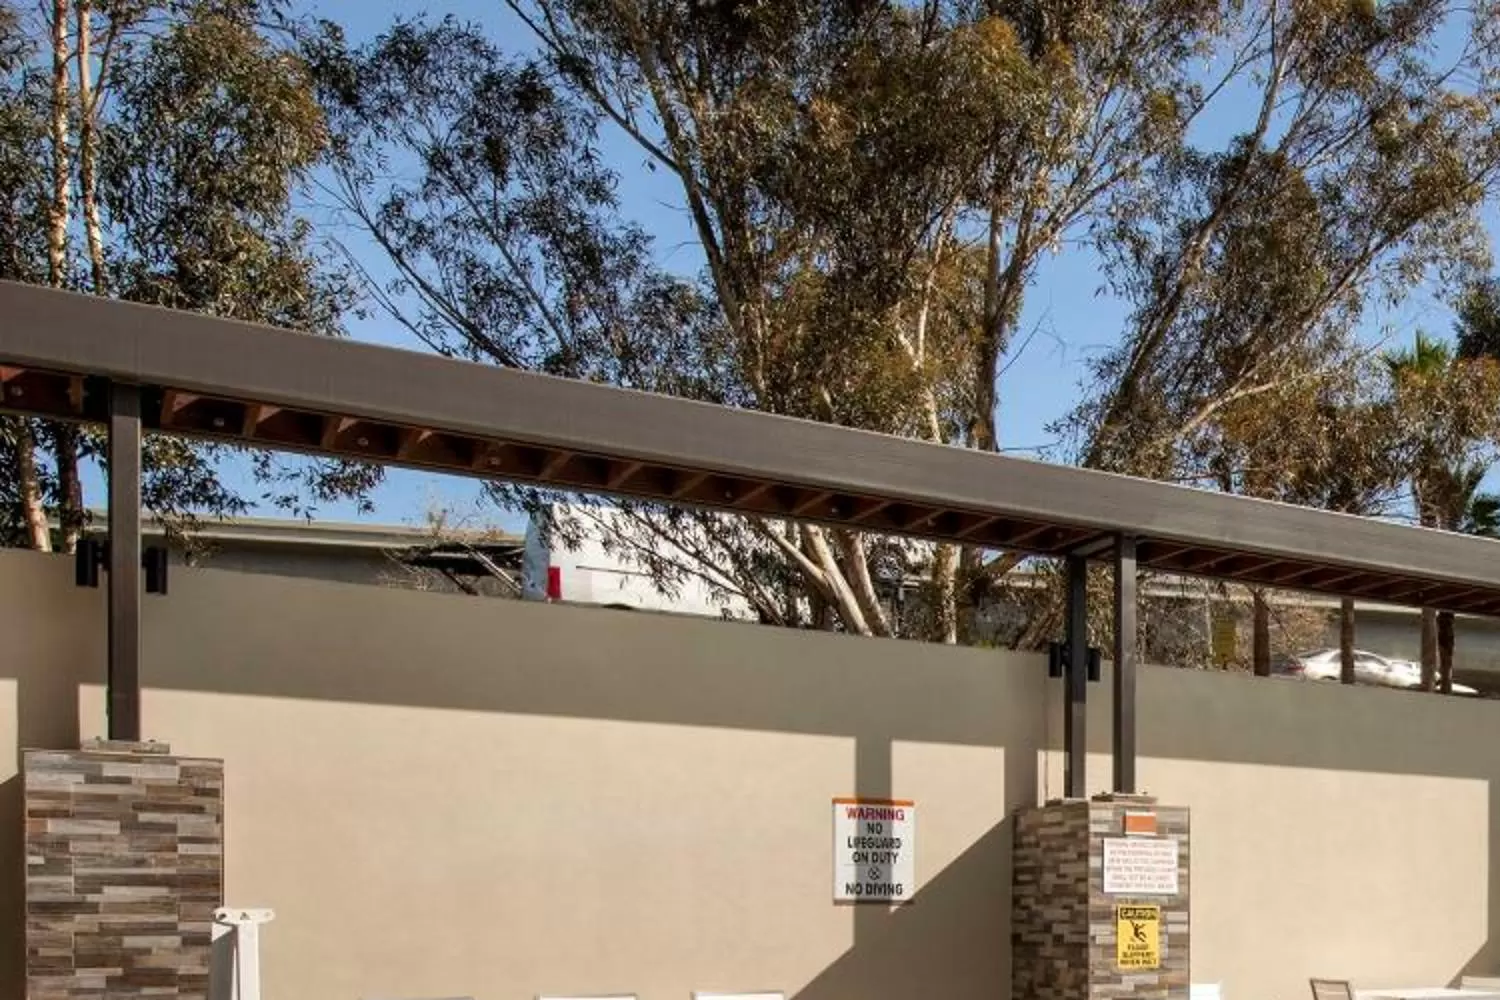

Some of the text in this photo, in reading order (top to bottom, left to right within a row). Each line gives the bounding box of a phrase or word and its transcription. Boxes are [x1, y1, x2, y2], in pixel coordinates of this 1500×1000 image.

[846, 808, 905, 821] WARNING
[867, 822, 883, 834] NO
[847, 836, 902, 849] LIFEGUARD
[852, 851, 899, 865] ON DUTY
[845, 883, 903, 896] NO DIVING
